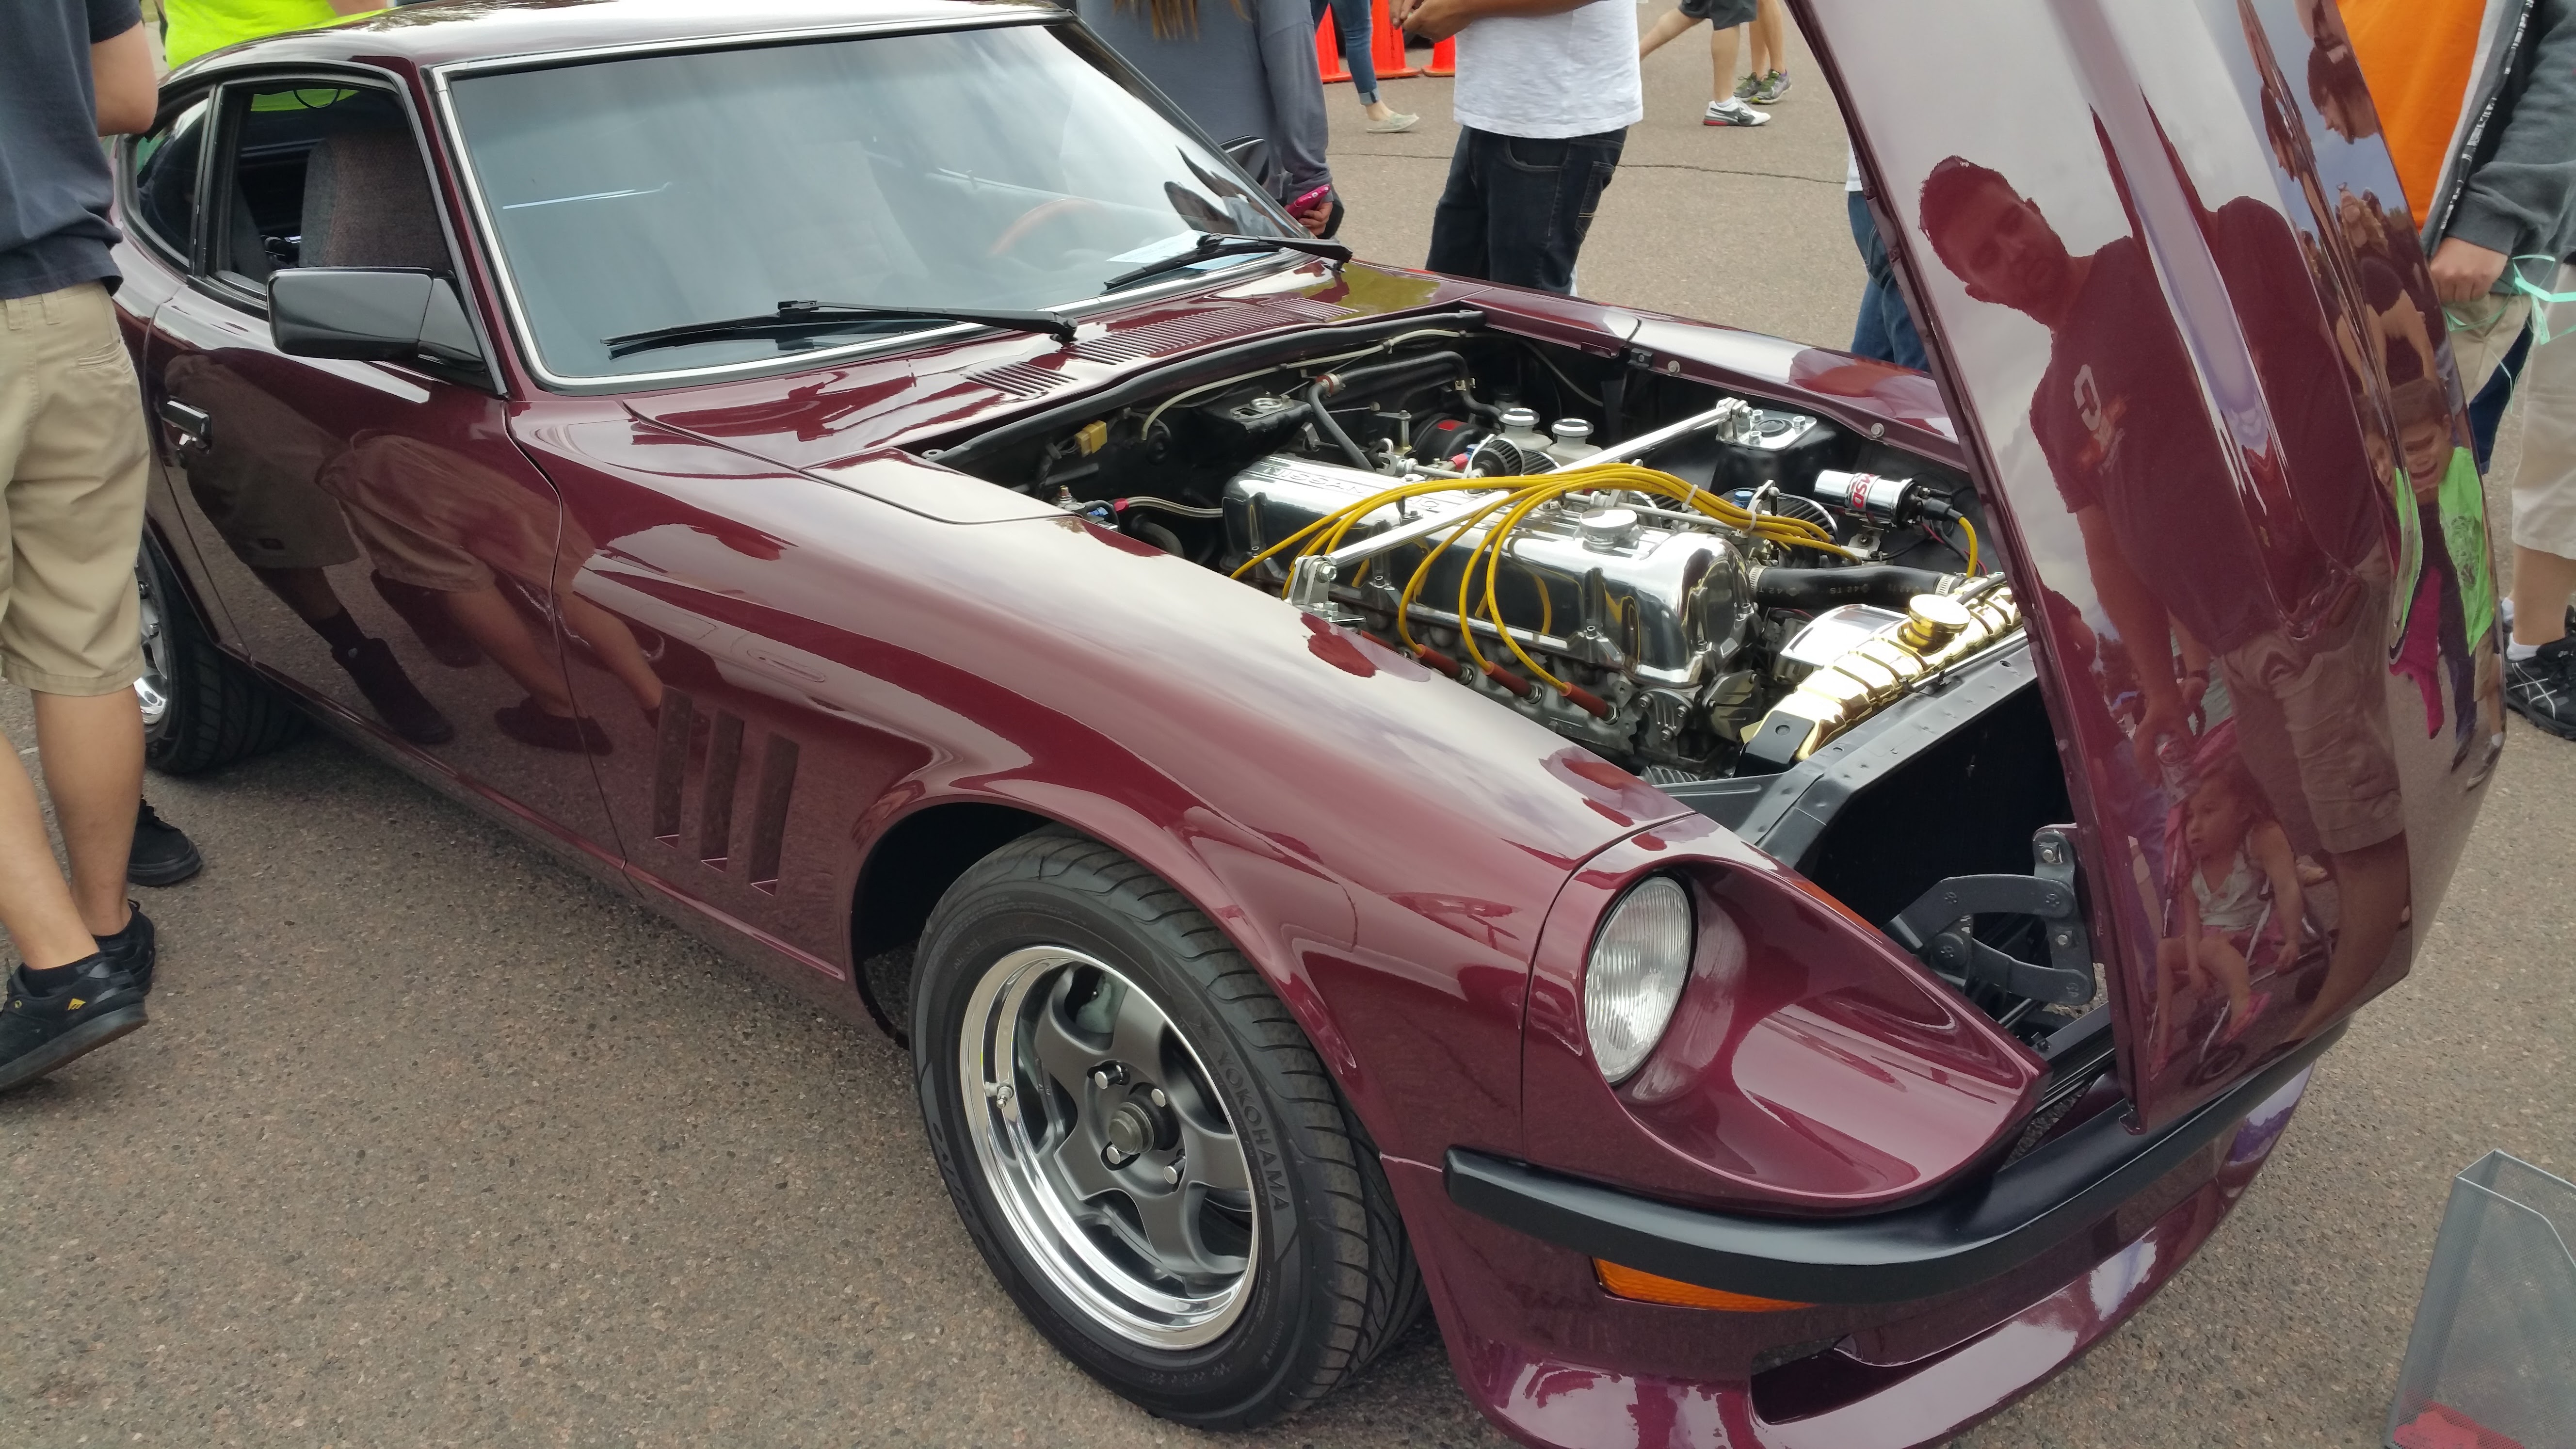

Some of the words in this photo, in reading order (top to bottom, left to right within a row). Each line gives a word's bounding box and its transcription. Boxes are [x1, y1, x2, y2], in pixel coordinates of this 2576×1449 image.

[1262, 467, 1368, 494] NISSAN
[1852, 473, 1876, 509] MSD
[1217, 1049, 1290, 1211] YOKOHAMA
